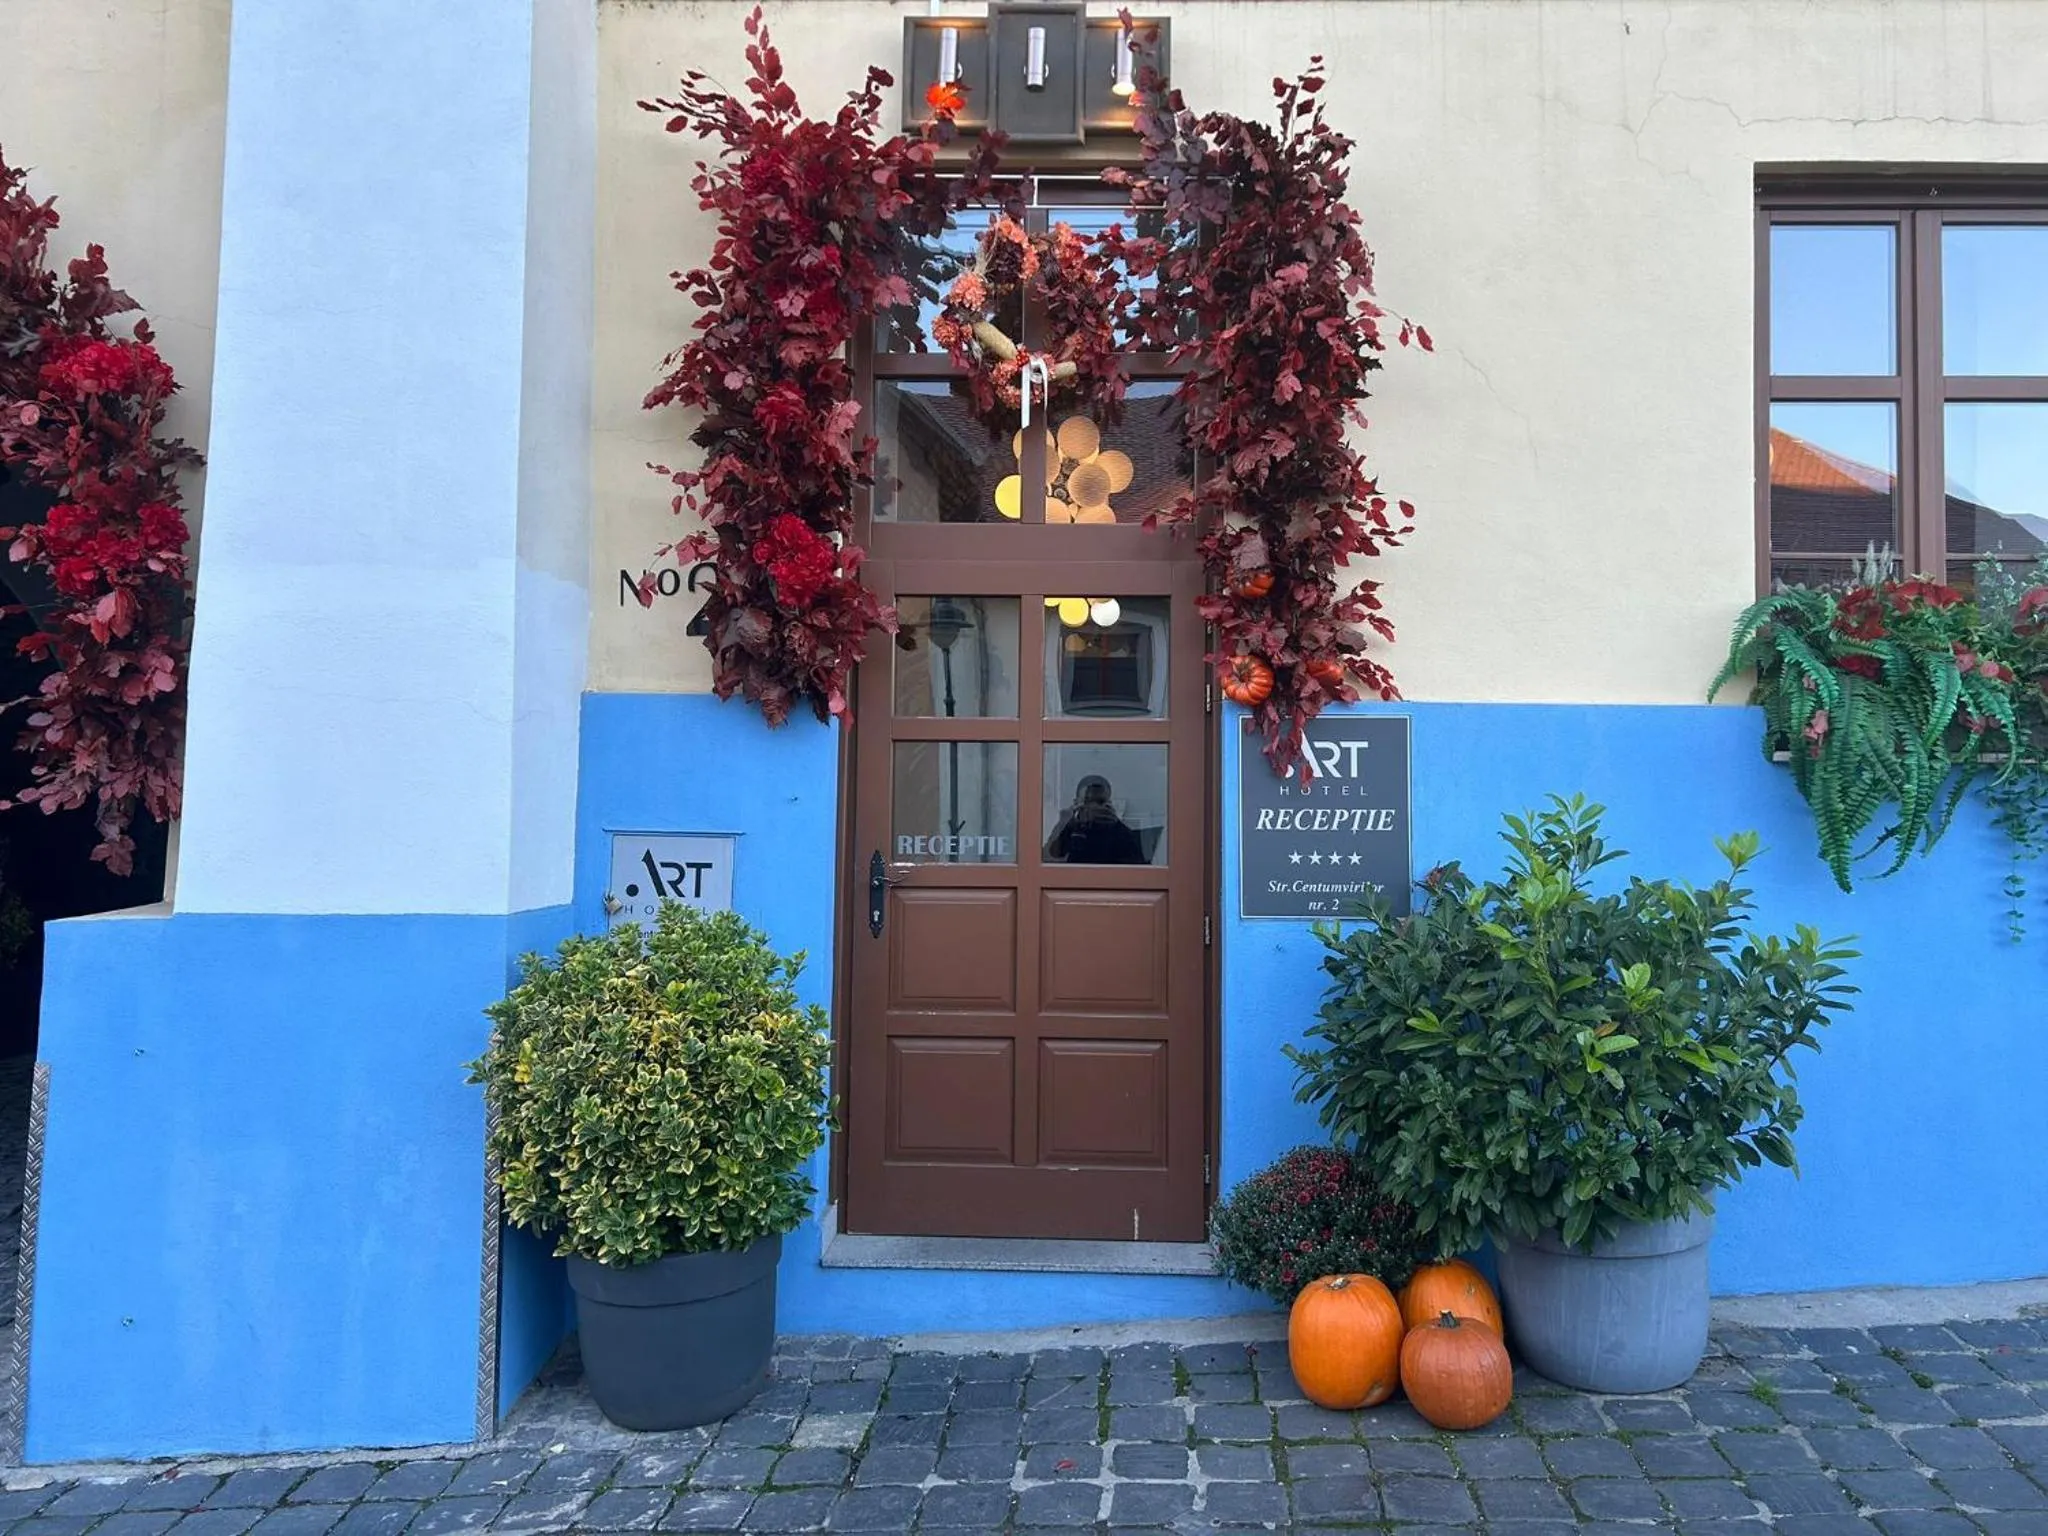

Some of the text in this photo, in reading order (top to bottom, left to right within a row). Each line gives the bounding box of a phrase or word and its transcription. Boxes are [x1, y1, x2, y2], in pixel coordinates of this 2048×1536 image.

[1284, 727, 1369, 779] ART
[1279, 785, 1369, 796] HOTEL
[897, 834, 1011, 856] RECEPTIE
[625, 848, 713, 898] ART
[624, 904, 709, 916] HOL
[1308, 898, 1340, 911] nr. 2
